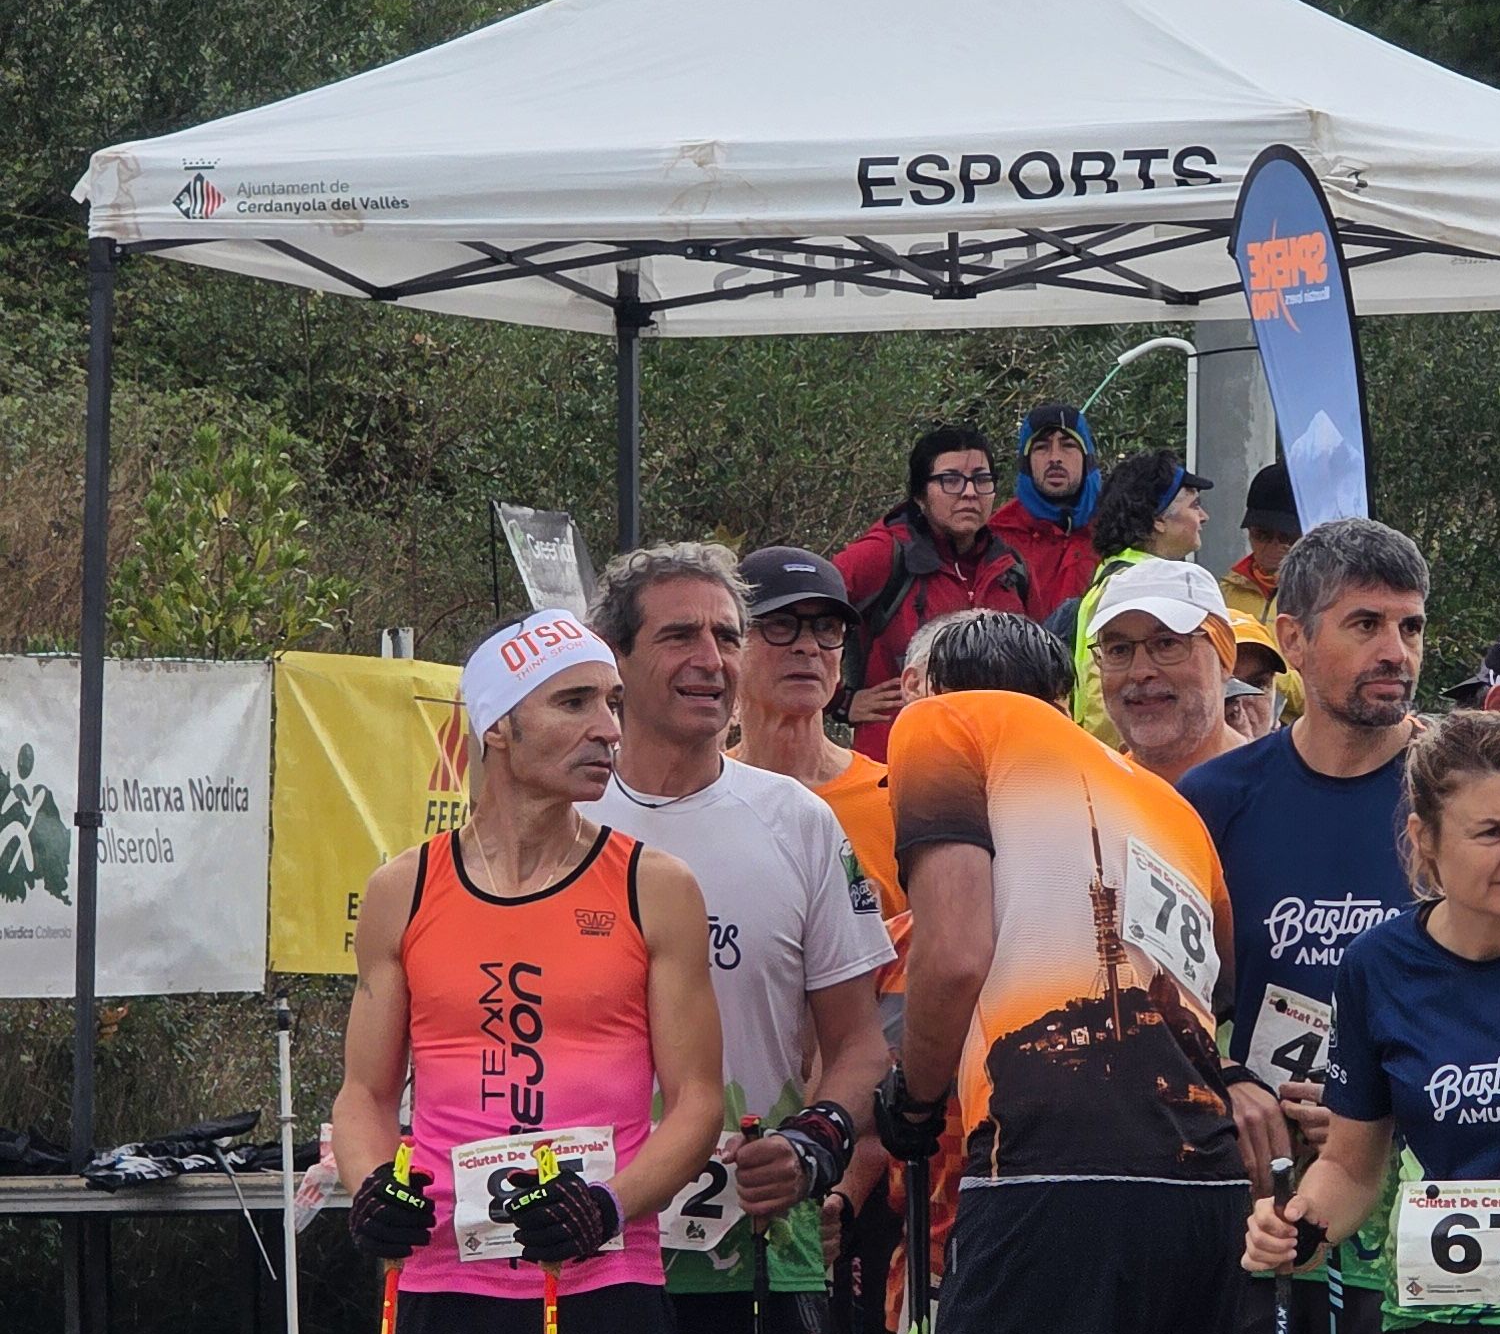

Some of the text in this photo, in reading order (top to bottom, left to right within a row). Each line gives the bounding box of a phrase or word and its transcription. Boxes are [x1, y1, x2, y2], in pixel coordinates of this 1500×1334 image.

[236, 179, 350, 198] Ajuntament de
[857, 145, 1223, 208] ESPORTS
[236, 196, 410, 216] Cerdanyola del Vallès
[500, 619, 583, 672] OTSO
[122, 778, 185, 813] Marxa
[188, 774, 249, 813] Nòrdica
[97, 827, 175, 865] ollserola
[1150, 874, 1206, 964] 78
[1294, 946, 1344, 966] AMU
[478, 961, 506, 1112] TEAM
[507, 1151, 526, 1161] De
[385, 1182, 426, 1209] LEKI
[510, 1188, 548, 1211] LEKI
[1460, 1198, 1478, 1208] De
